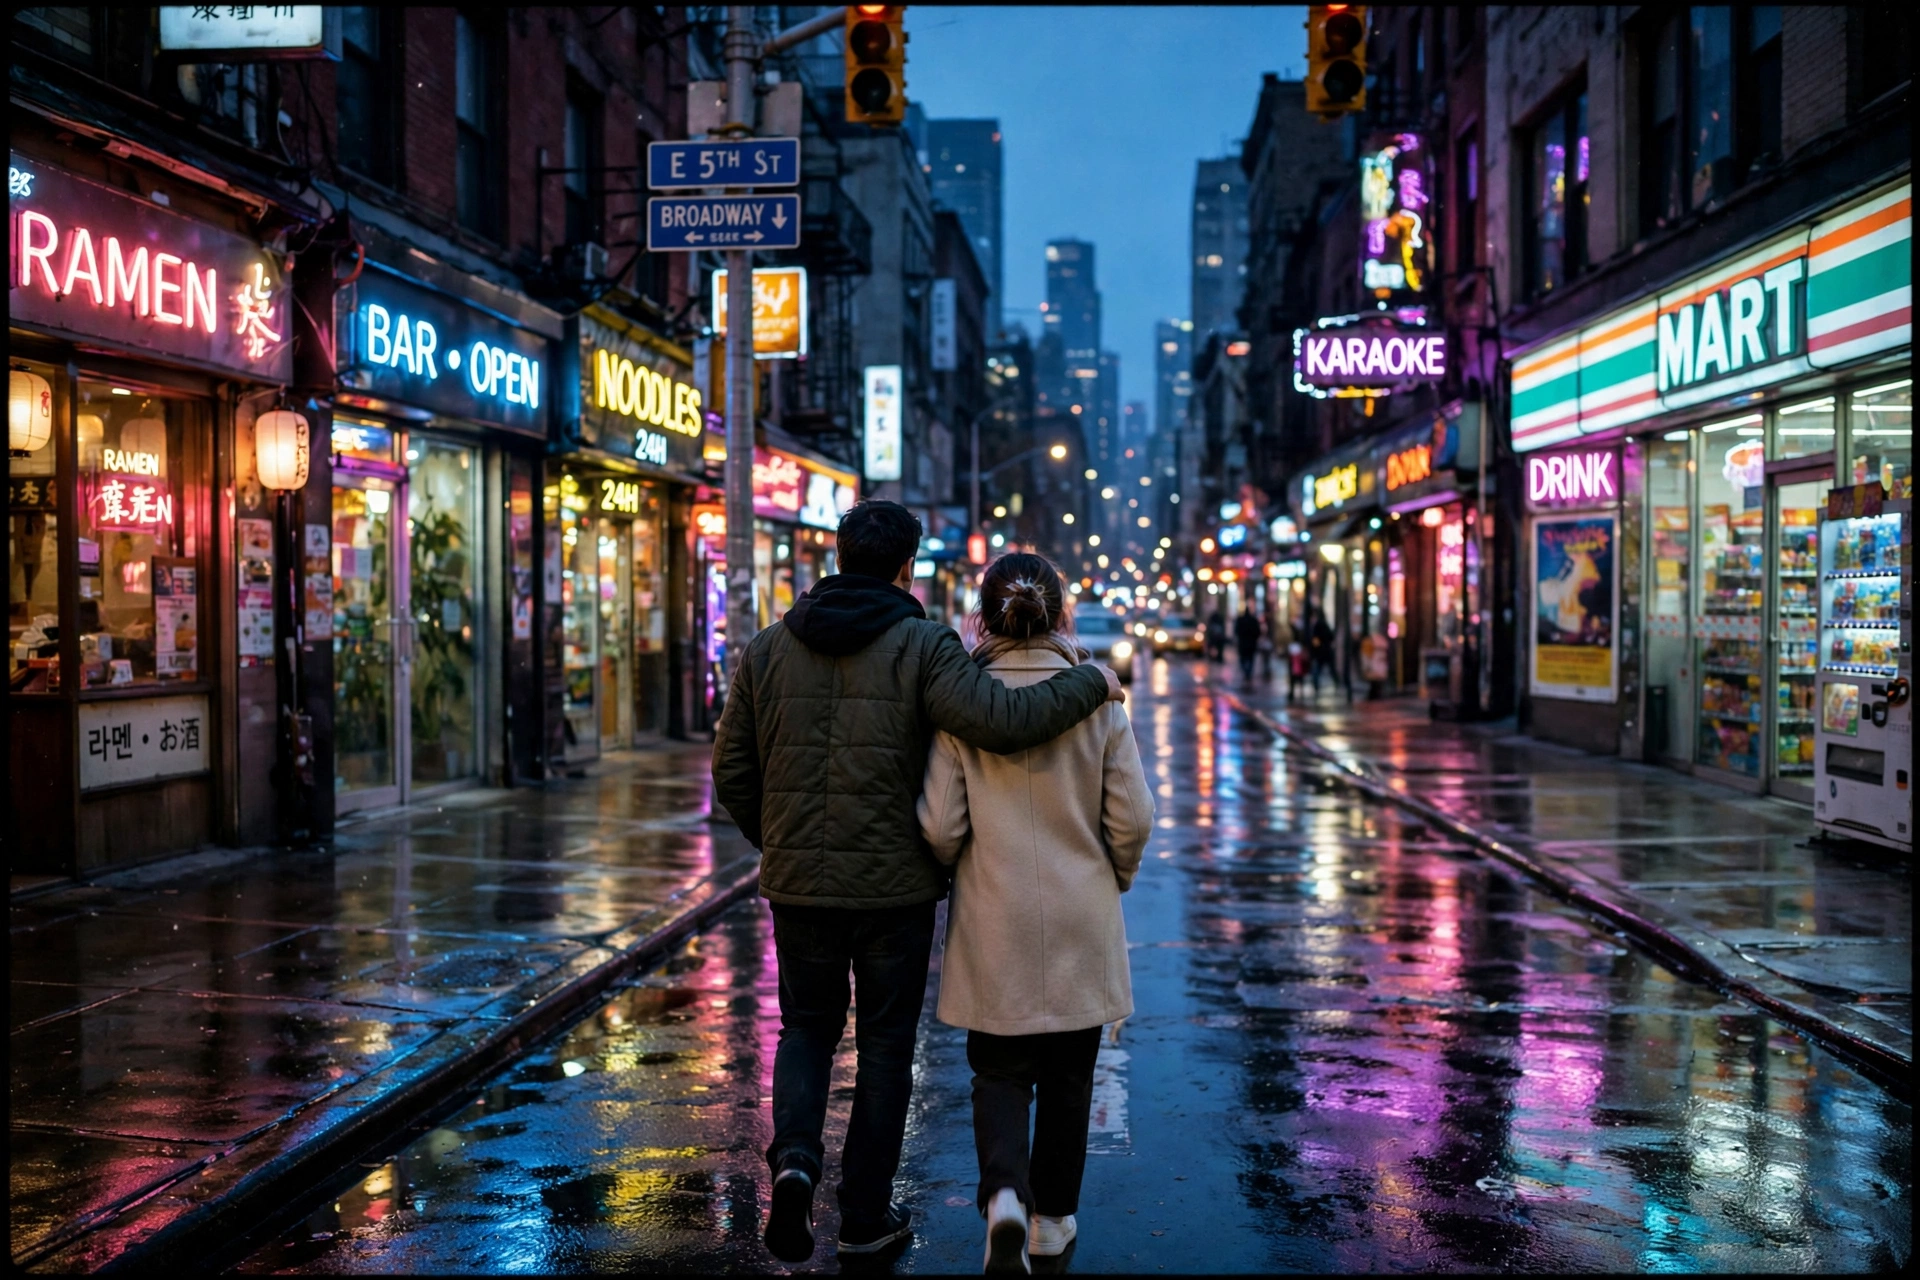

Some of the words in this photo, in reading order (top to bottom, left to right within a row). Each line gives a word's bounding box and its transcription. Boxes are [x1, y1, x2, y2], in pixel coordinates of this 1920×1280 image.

[671, 152, 686, 178] E
[699, 150, 740, 179] 5TH
[661, 203, 765, 228] BROADWAY
[21, 210, 217, 333] RAMEN
[1658, 258, 1803, 392] MART
[367, 303, 438, 380] BAR
[470, 341, 539, 410] OPEN
[1307, 337, 1445, 375] KARAOKE
[597, 349, 702, 438] NOODLES
[103, 448, 159, 476] RAMEN
[635, 428, 667, 465] 24H
[601, 478, 639, 513] 24H
[1529, 452, 1613, 501] DRINK
[88, 722, 132, 762] 라멘
[160, 717, 199, 752] お酒
